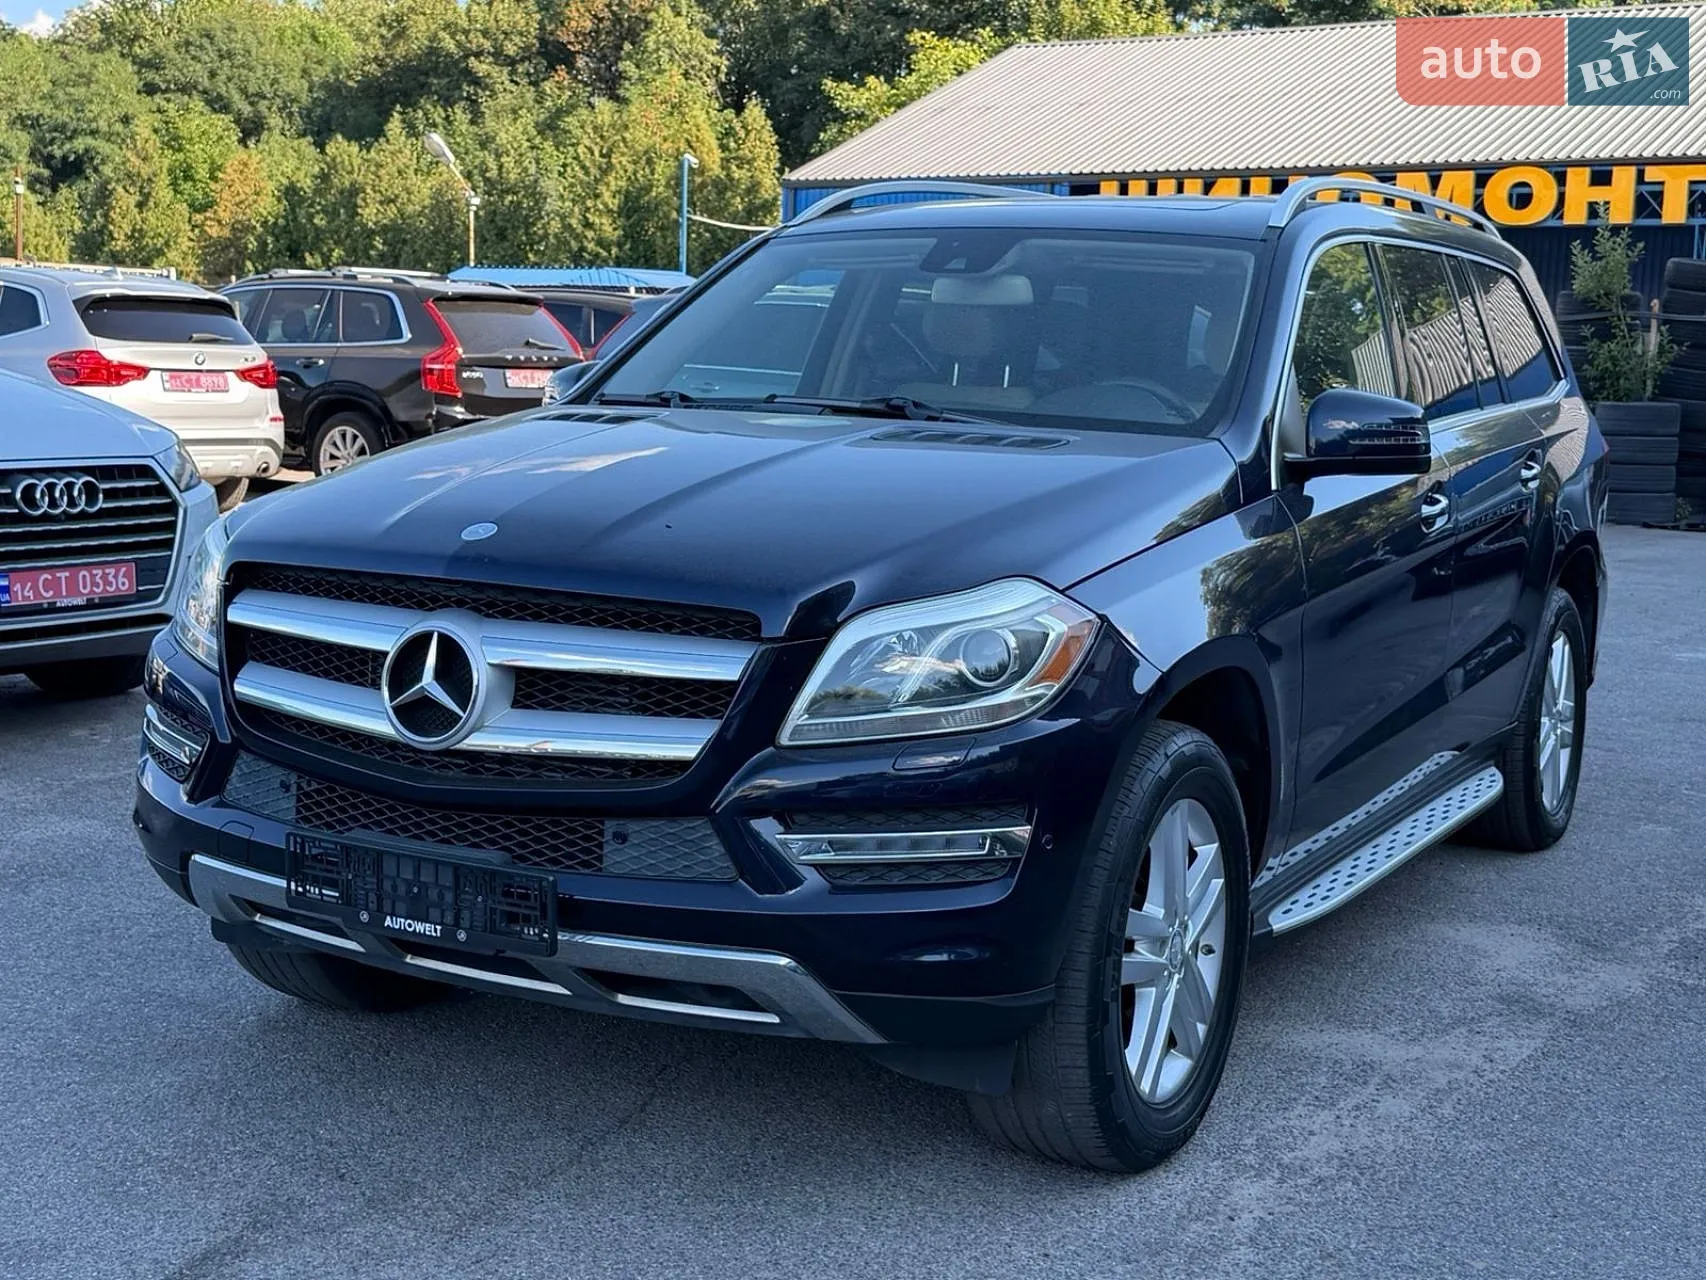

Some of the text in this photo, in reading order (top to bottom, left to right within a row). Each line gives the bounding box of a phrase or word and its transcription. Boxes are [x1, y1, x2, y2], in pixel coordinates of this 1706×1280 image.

[13, 566, 129, 601] 14 CT 0336
[383, 914, 442, 938] AUTOWELT
